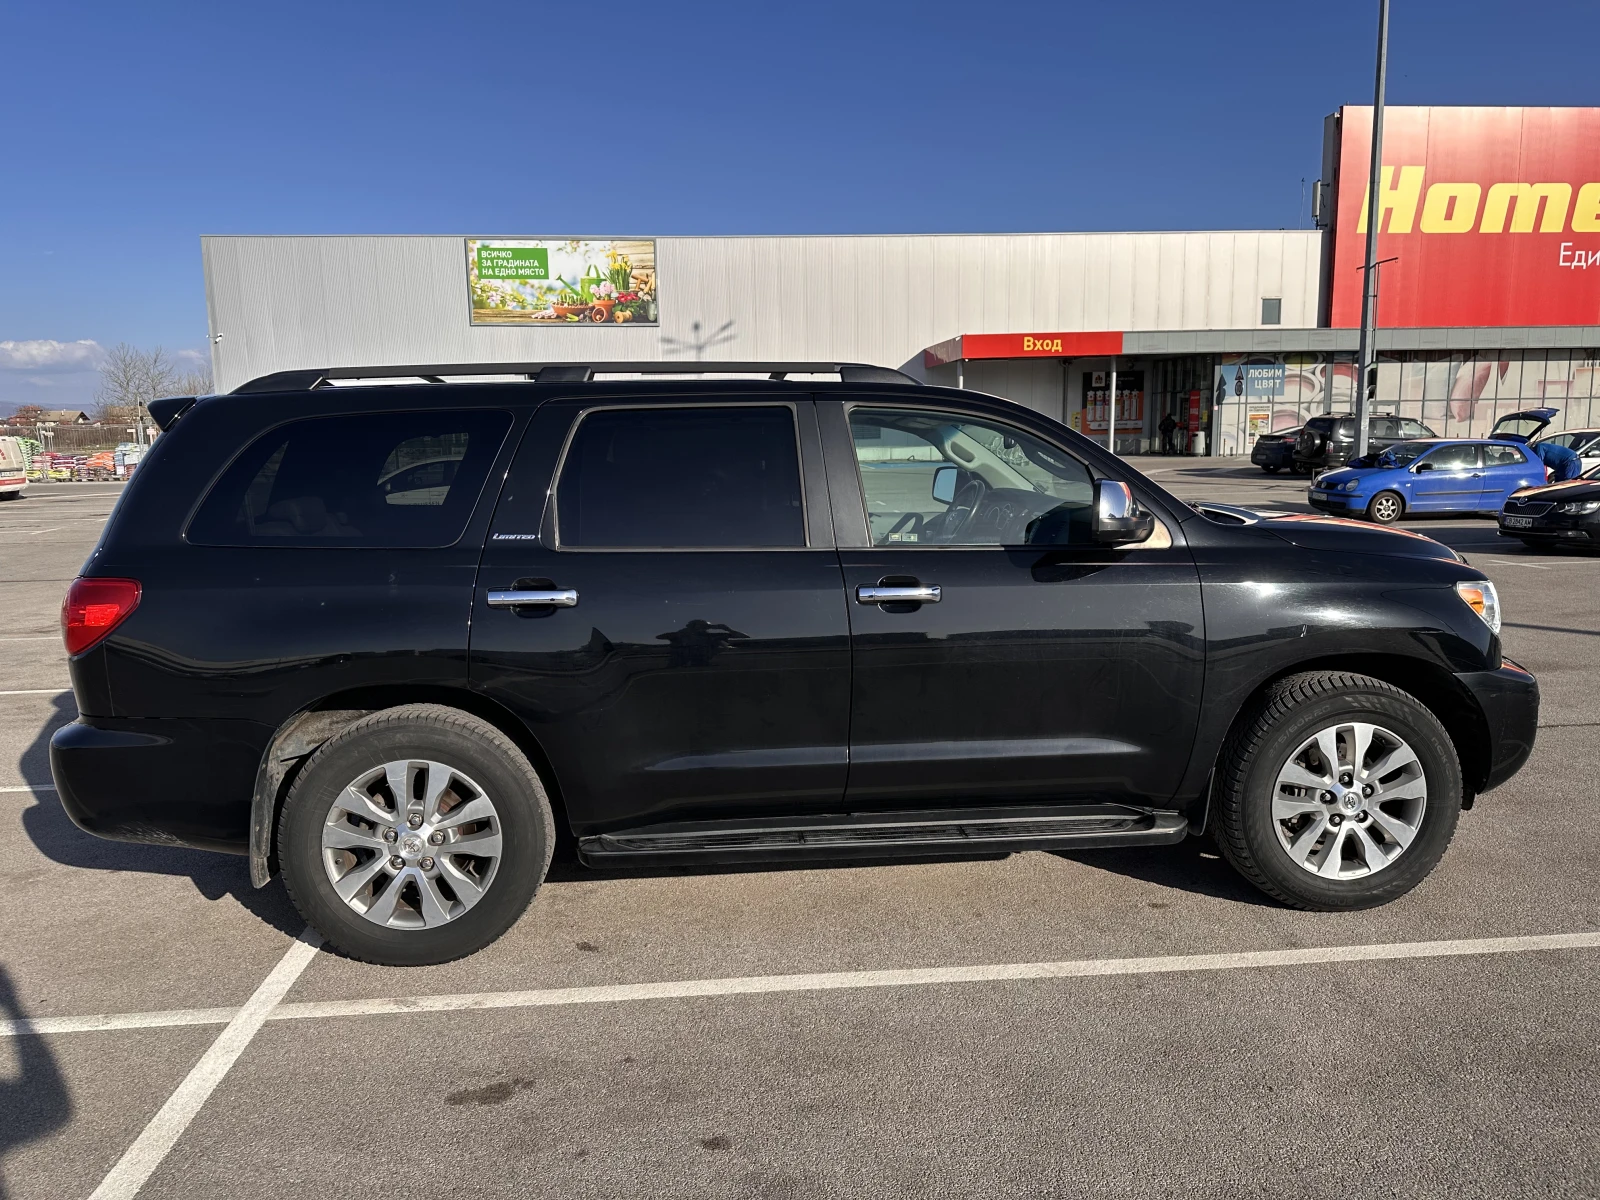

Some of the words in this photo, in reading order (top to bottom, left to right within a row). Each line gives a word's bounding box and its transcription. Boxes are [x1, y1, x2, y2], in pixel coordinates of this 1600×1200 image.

[481, 250, 512, 258] ВСИЧКО
[1559, 242, 1600, 270] Еди
[481, 259, 492, 267] ЗА
[493, 259, 539, 267] ГРАДИНАТА
[495, 268, 516, 277] ЕДНО
[1023, 336, 1062, 352] Вход
[1248, 368, 1282, 378] ЛЮБИМ
[1254, 380, 1281, 389] ЦВЯТ
